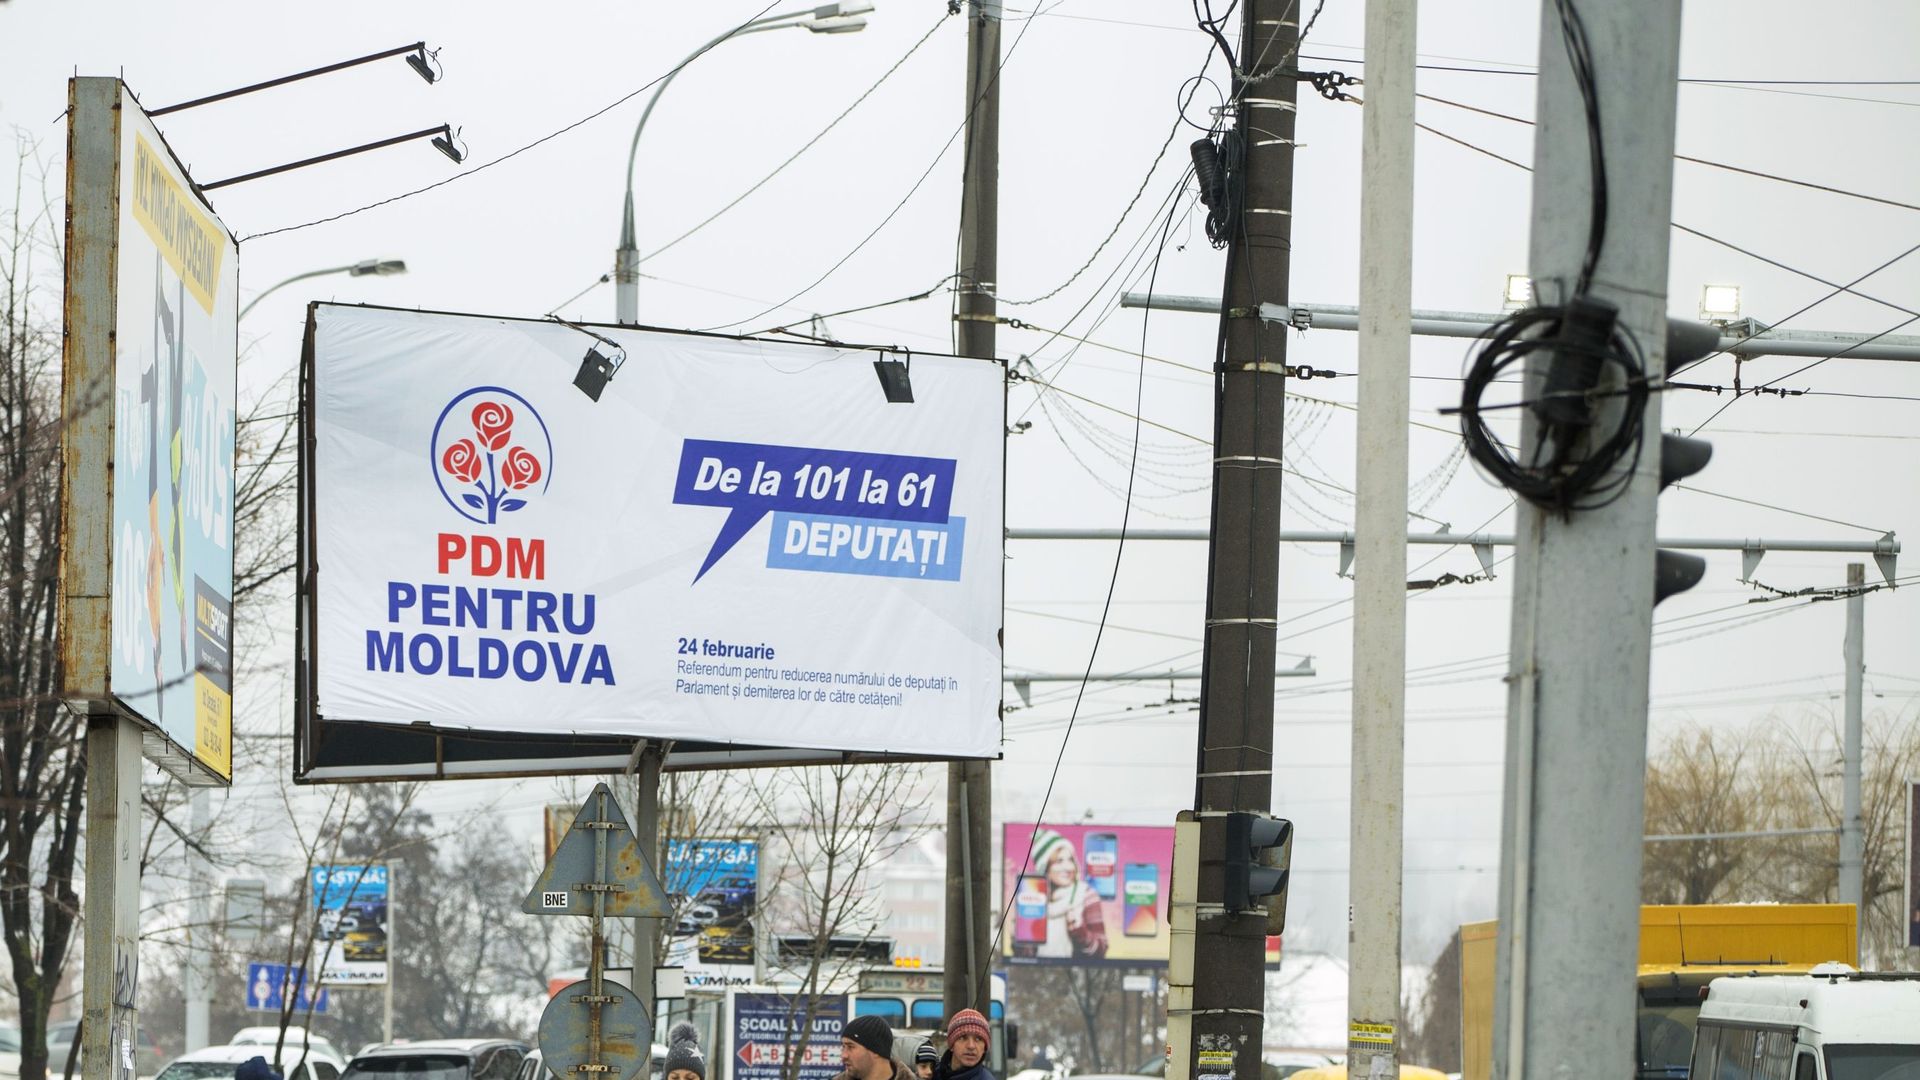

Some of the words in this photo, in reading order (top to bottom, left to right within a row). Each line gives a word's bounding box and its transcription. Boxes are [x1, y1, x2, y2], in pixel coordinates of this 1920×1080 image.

[693, 457, 742, 493] De
[749, 461, 782, 496] la
[794, 464, 851, 501] 101
[858, 470, 889, 504] la
[898, 472, 936, 508] 61
[437, 532, 545, 581] PDM
[784, 520, 948, 576] DEPUTAȚI
[388, 581, 596, 635] PENTRU
[366, 629, 616, 686] MOLDOVA
[678, 637, 698, 655] 24
[702, 639, 775, 660] februarie
[676, 679, 729, 696] Parlament
[732, 683, 741, 700] și
[743, 685, 795, 701] demiterea
[798, 687, 811, 701] lor
[814, 689, 826, 702] de
[829, 690, 855, 703] către
[858, 692, 903, 709] cetățeni!
[677, 660, 742, 677] Referendum
[744, 667, 778, 681] pentru
[781, 667, 832, 684] reducerea
[834, 672, 885, 687] numărului
[888, 674, 902, 688] de
[905, 675, 946, 694] deputați
[949, 677, 958, 691] în
[545, 894, 566, 906] BNE
[684, 976, 751, 986] AXIMUM
[802, 1019, 842, 1033] UTO
